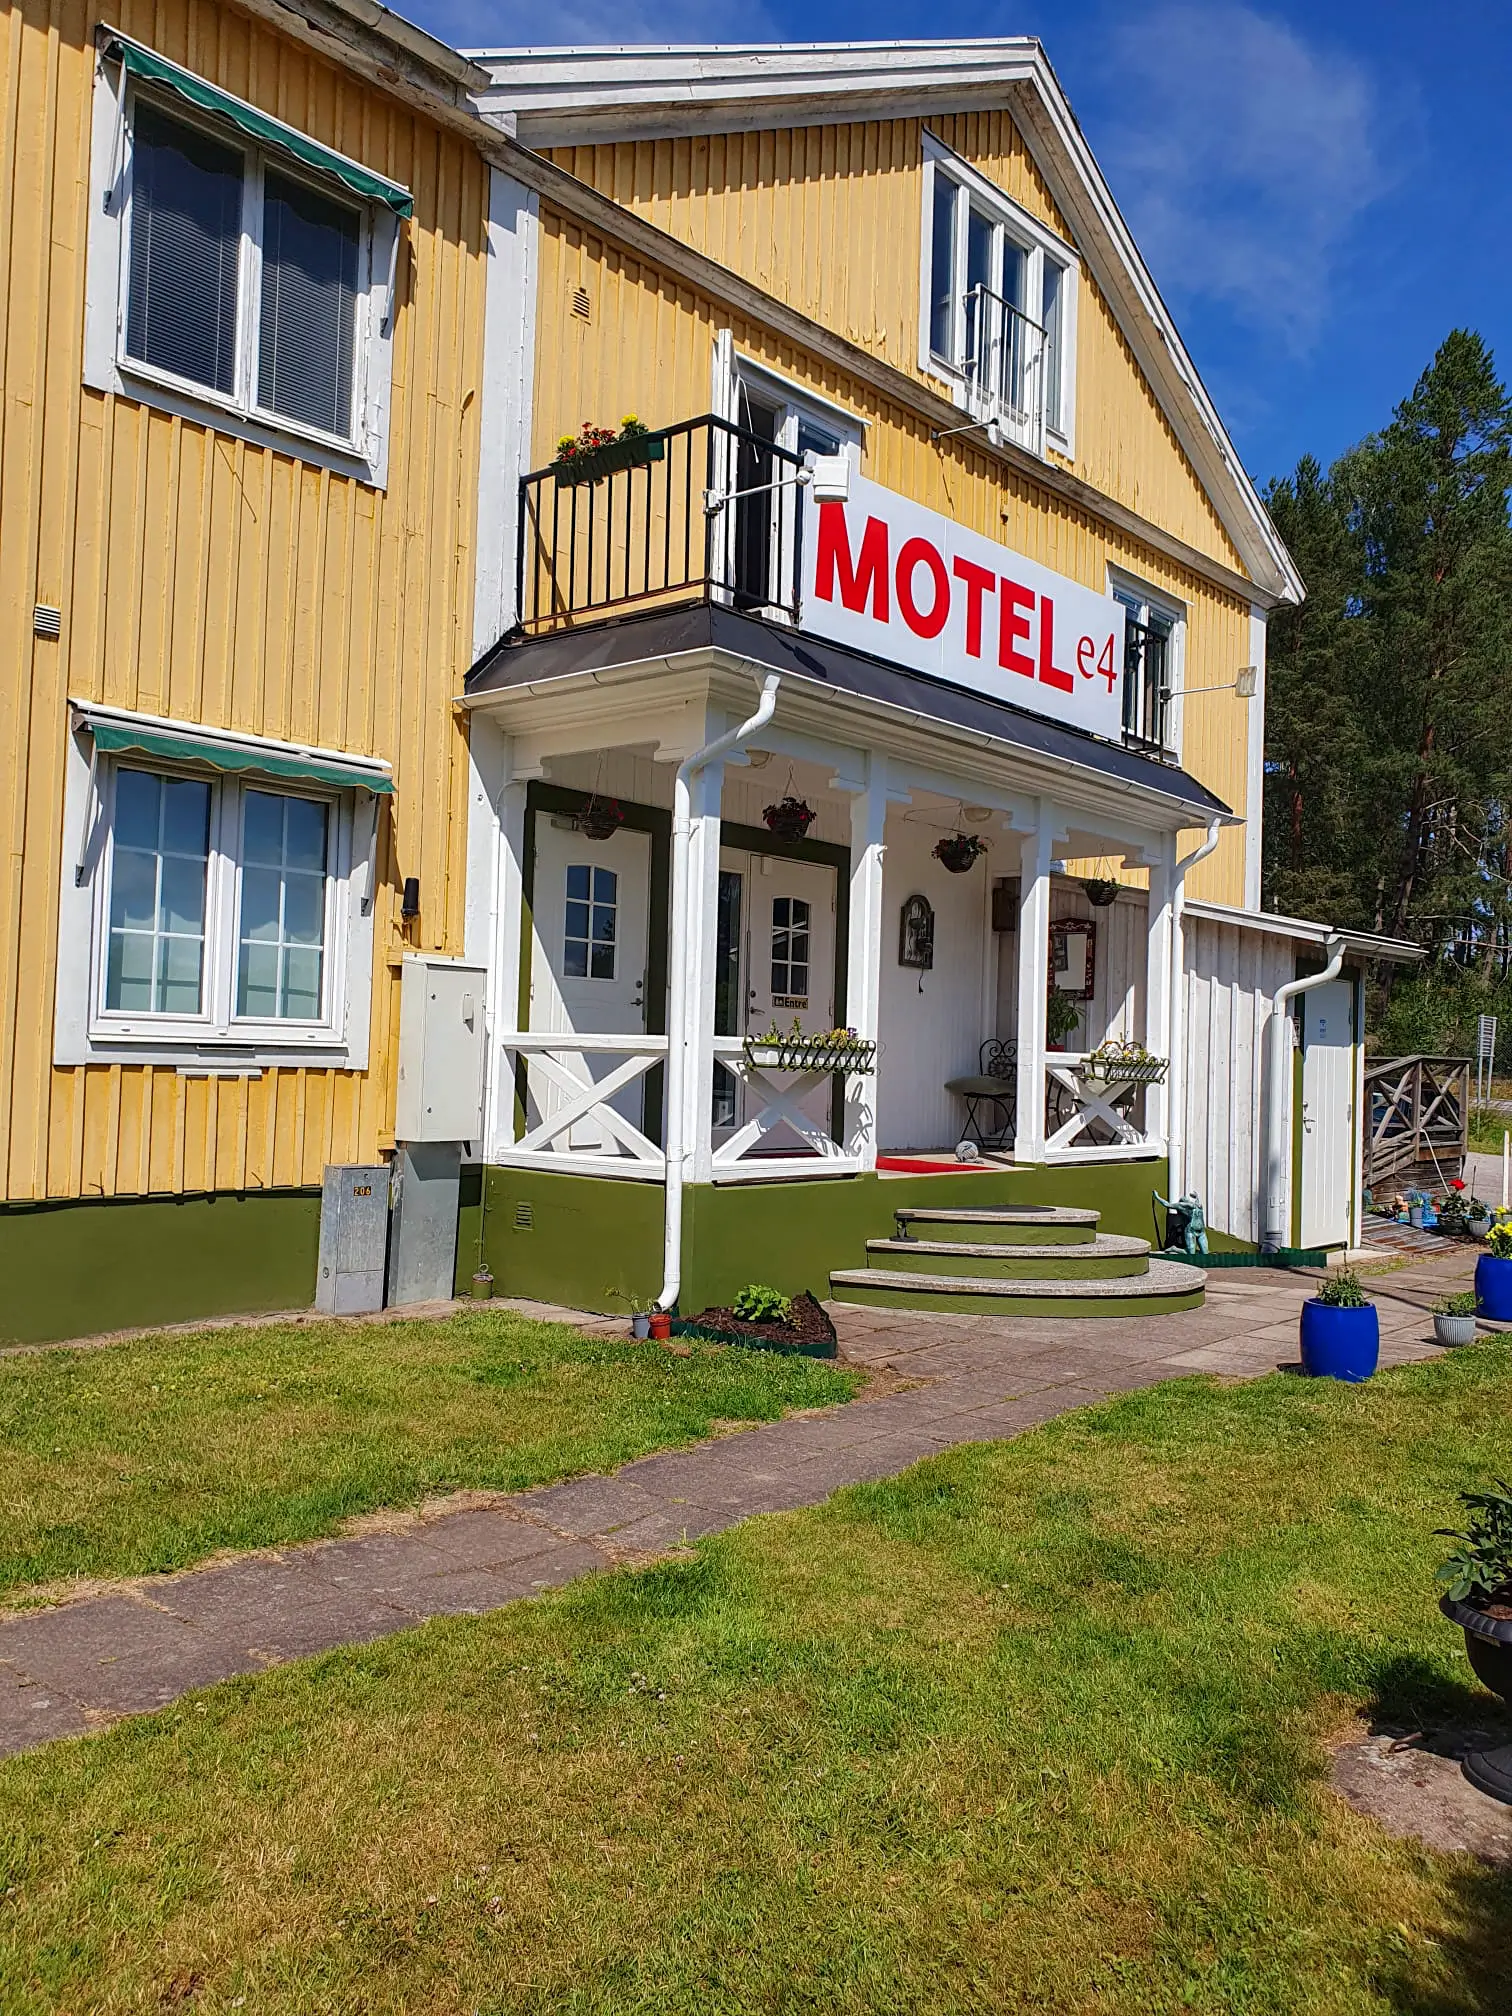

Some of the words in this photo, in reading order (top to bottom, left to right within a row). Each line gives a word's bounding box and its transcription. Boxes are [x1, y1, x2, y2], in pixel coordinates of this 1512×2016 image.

[814, 500, 1075, 694] MOTEL
[1076, 634, 1117, 694] e4
[354, 1187, 371, 1196] 206
